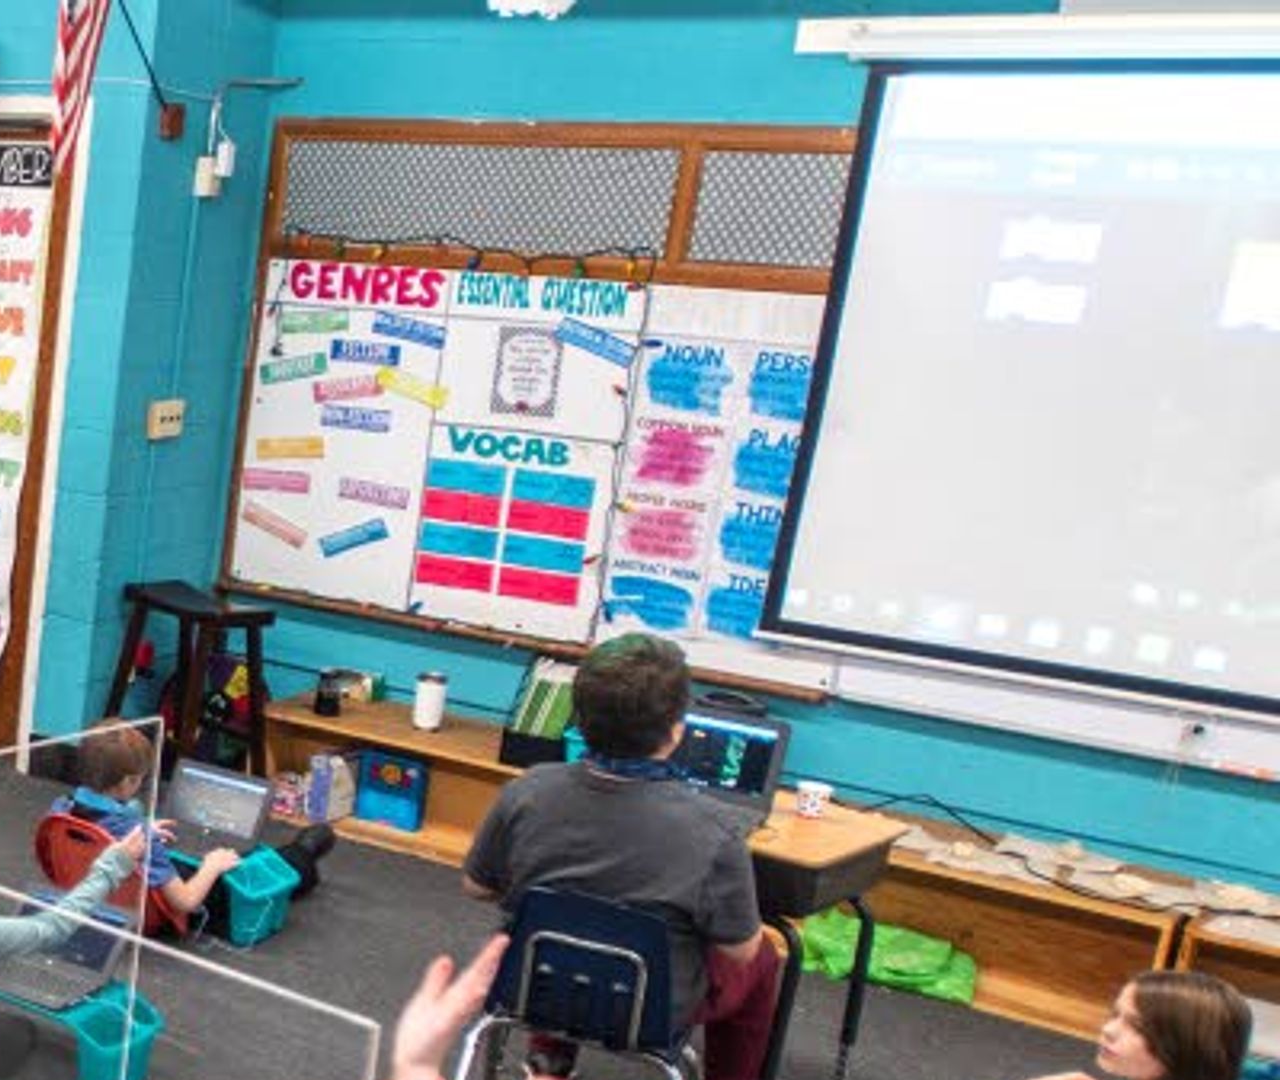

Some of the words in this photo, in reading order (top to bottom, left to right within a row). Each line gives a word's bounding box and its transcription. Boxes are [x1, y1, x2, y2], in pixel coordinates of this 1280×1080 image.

[290, 263, 446, 308] GENRES
[457, 272, 530, 308] ESSENTIAL
[541, 278, 628, 317] QUESTION
[665, 345, 726, 368] NOUN
[448, 427, 569, 466] VOCAB
